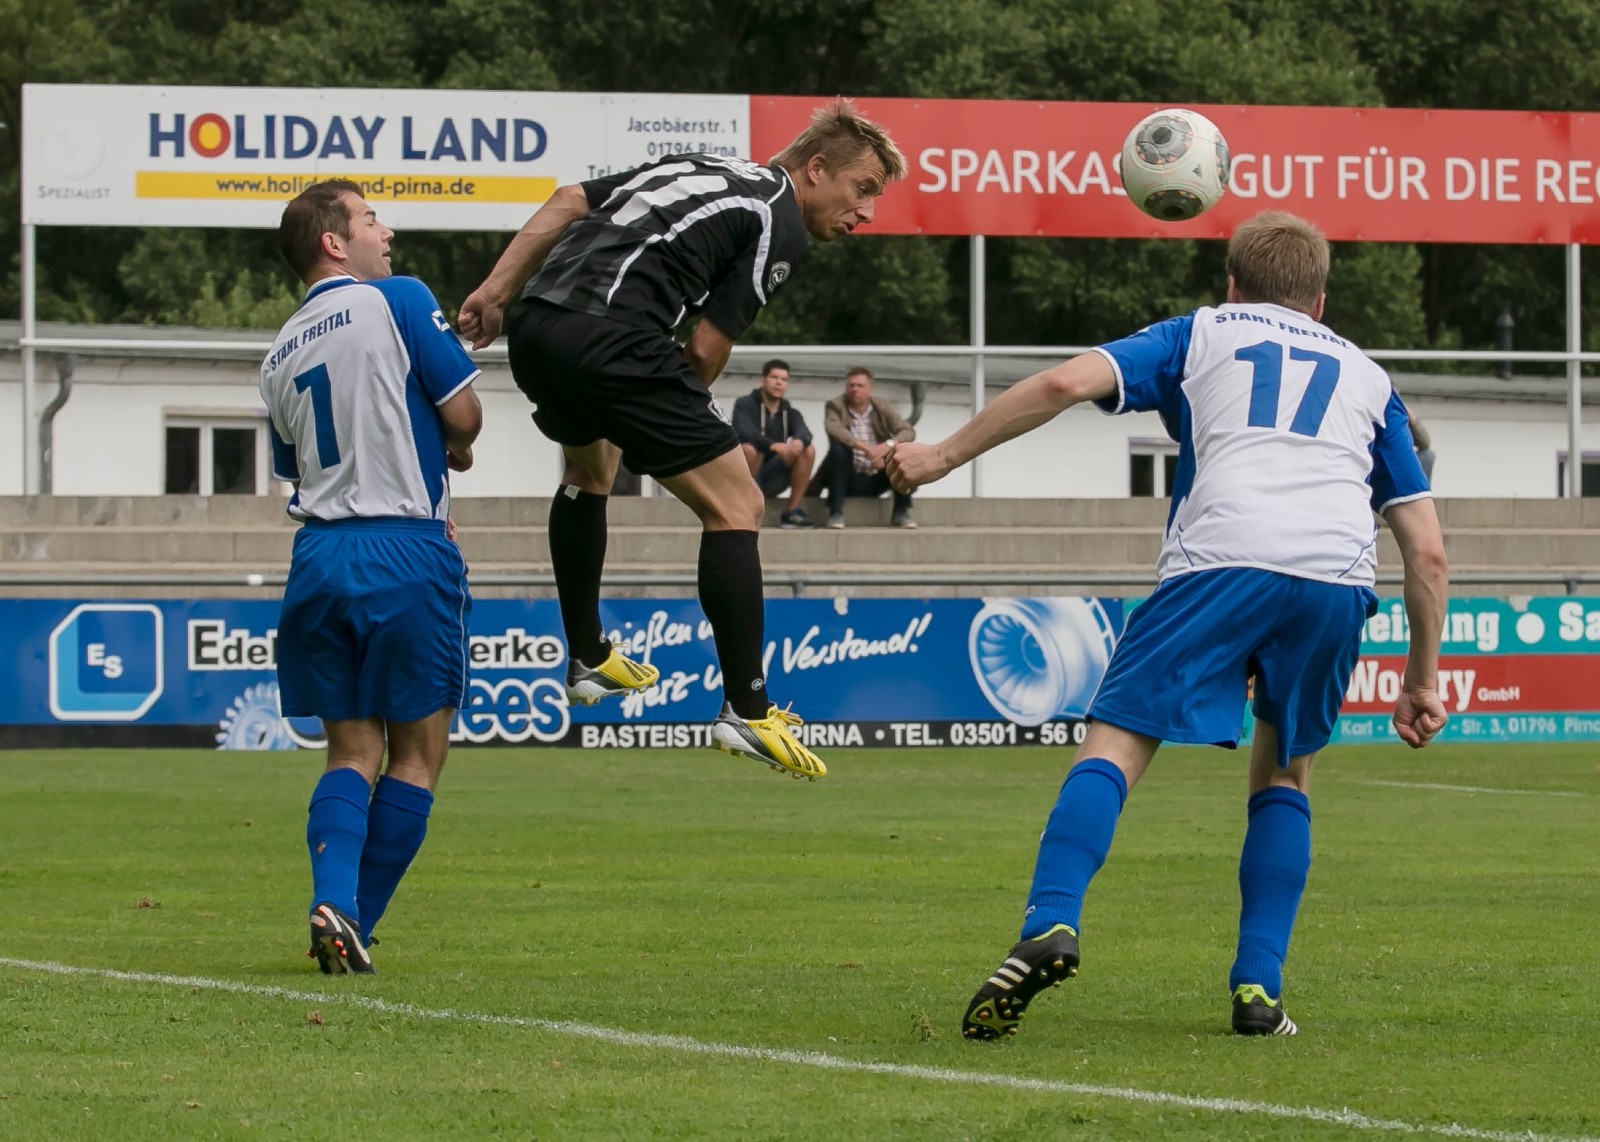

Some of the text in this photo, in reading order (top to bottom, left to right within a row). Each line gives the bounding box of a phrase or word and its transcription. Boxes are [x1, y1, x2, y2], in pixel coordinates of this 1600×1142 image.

[149, 112, 548, 163] HOLIDAY LAND
[731, 119, 737, 133] 1
[1228, 153, 1324, 199] GUT
[1337, 146, 1430, 201] FÜR
[1444, 157, 1521, 202] DIE
[1535, 158, 1600, 204] RE
[270, 308, 353, 372] STAHL FREITAL
[1215, 310, 1352, 349] STAHL FREITAL
[1234, 339, 1341, 438] 17
[292, 361, 342, 471] 1
[1558, 601, 1600, 642] Sa
[87, 643, 123, 679] ES
[783, 612, 933, 675] Verstand!
[1477, 686, 1520, 702] GmbH
[890, 723, 943, 746] TEL.
[950, 723, 1017, 746] 03501
[1039, 722, 1069, 745] 56
[1340, 719, 1373, 736] Karl
[1509, 716, 1558, 735] 01796
